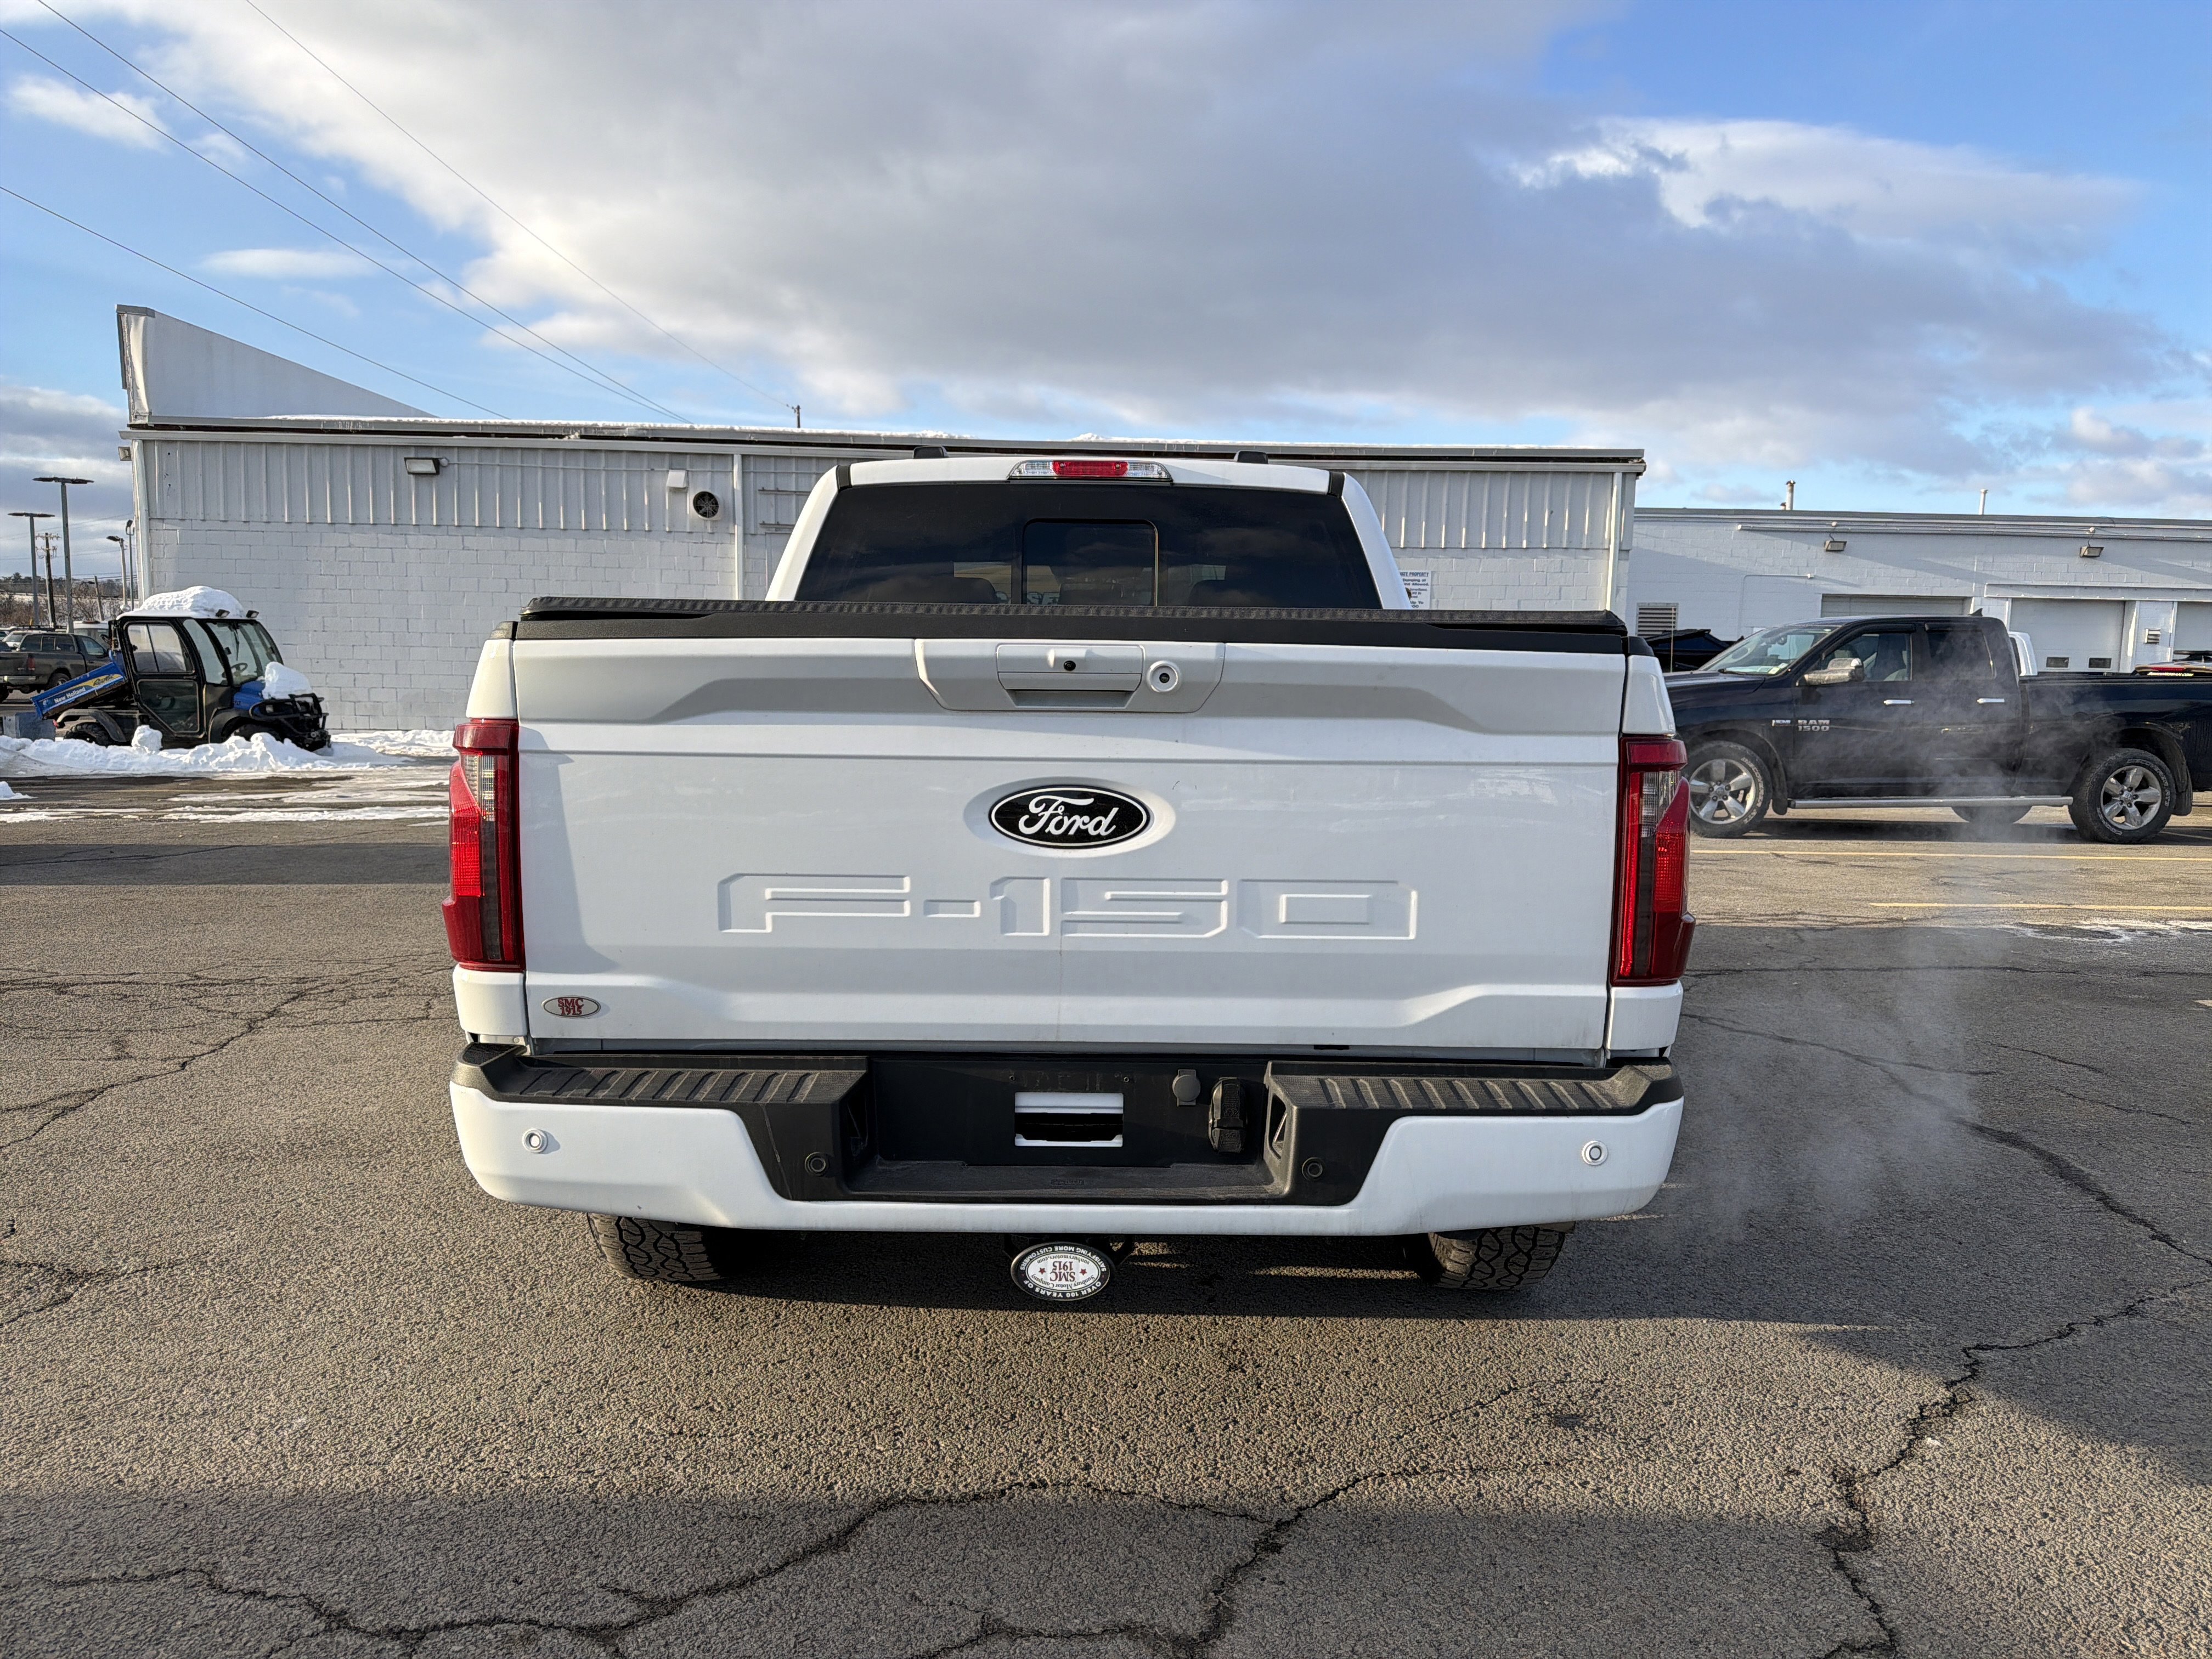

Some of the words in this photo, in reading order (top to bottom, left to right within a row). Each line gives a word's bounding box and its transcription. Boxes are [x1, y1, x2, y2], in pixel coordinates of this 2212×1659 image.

[54, 696, 66, 704] New
[66, 687, 86, 698] Holland
[2127, 759, 2169, 786] DISCOVERER
[1741, 757, 1764, 808] DISCOVERER
[1018, 795, 1120, 836] Ford
[718, 873, 1418, 939] F-150
[557, 998, 584, 1007] SMC
[560, 1006, 583, 1015] 1915
[1020, 1246, 1052, 1271] CUSTOMERS
[1037, 1254, 1090, 1265] sunburymotors.com
[1052, 1261, 1074, 1271] 1915
[1076, 1247, 1107, 1272] SATISFYING
[1023, 1279, 1034, 1288] OF
[1030, 1273, 1054, 1289] Company
[1049, 1271, 1075, 1282] SMC
[1073, 1274, 1095, 1288] Sunbury
[1035, 1286, 1063, 1297] YEARS
[1081, 1281, 1102, 1296] OVER
